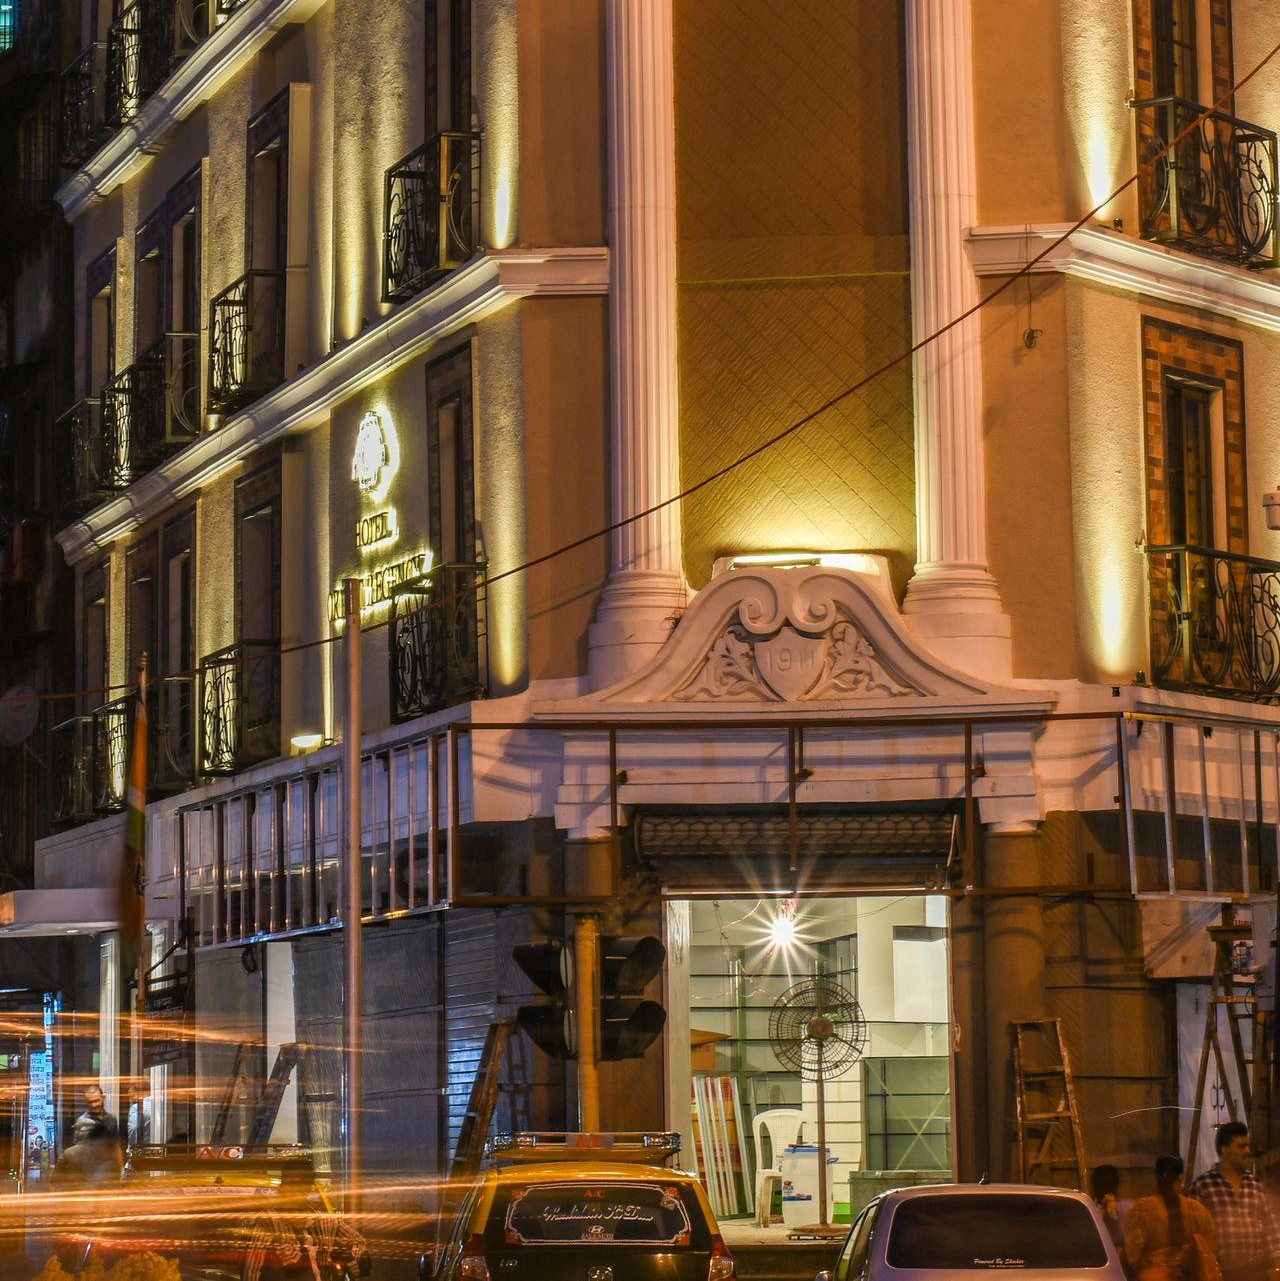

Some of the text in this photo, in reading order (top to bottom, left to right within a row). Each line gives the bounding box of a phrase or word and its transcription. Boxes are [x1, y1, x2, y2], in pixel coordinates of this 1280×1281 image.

[355, 511, 392, 549] HOTEL
[199, 1146, 241, 1160] A/C
[584, 1189, 606, 1198] A/C
[996, 1257, 1004, 1265] By
